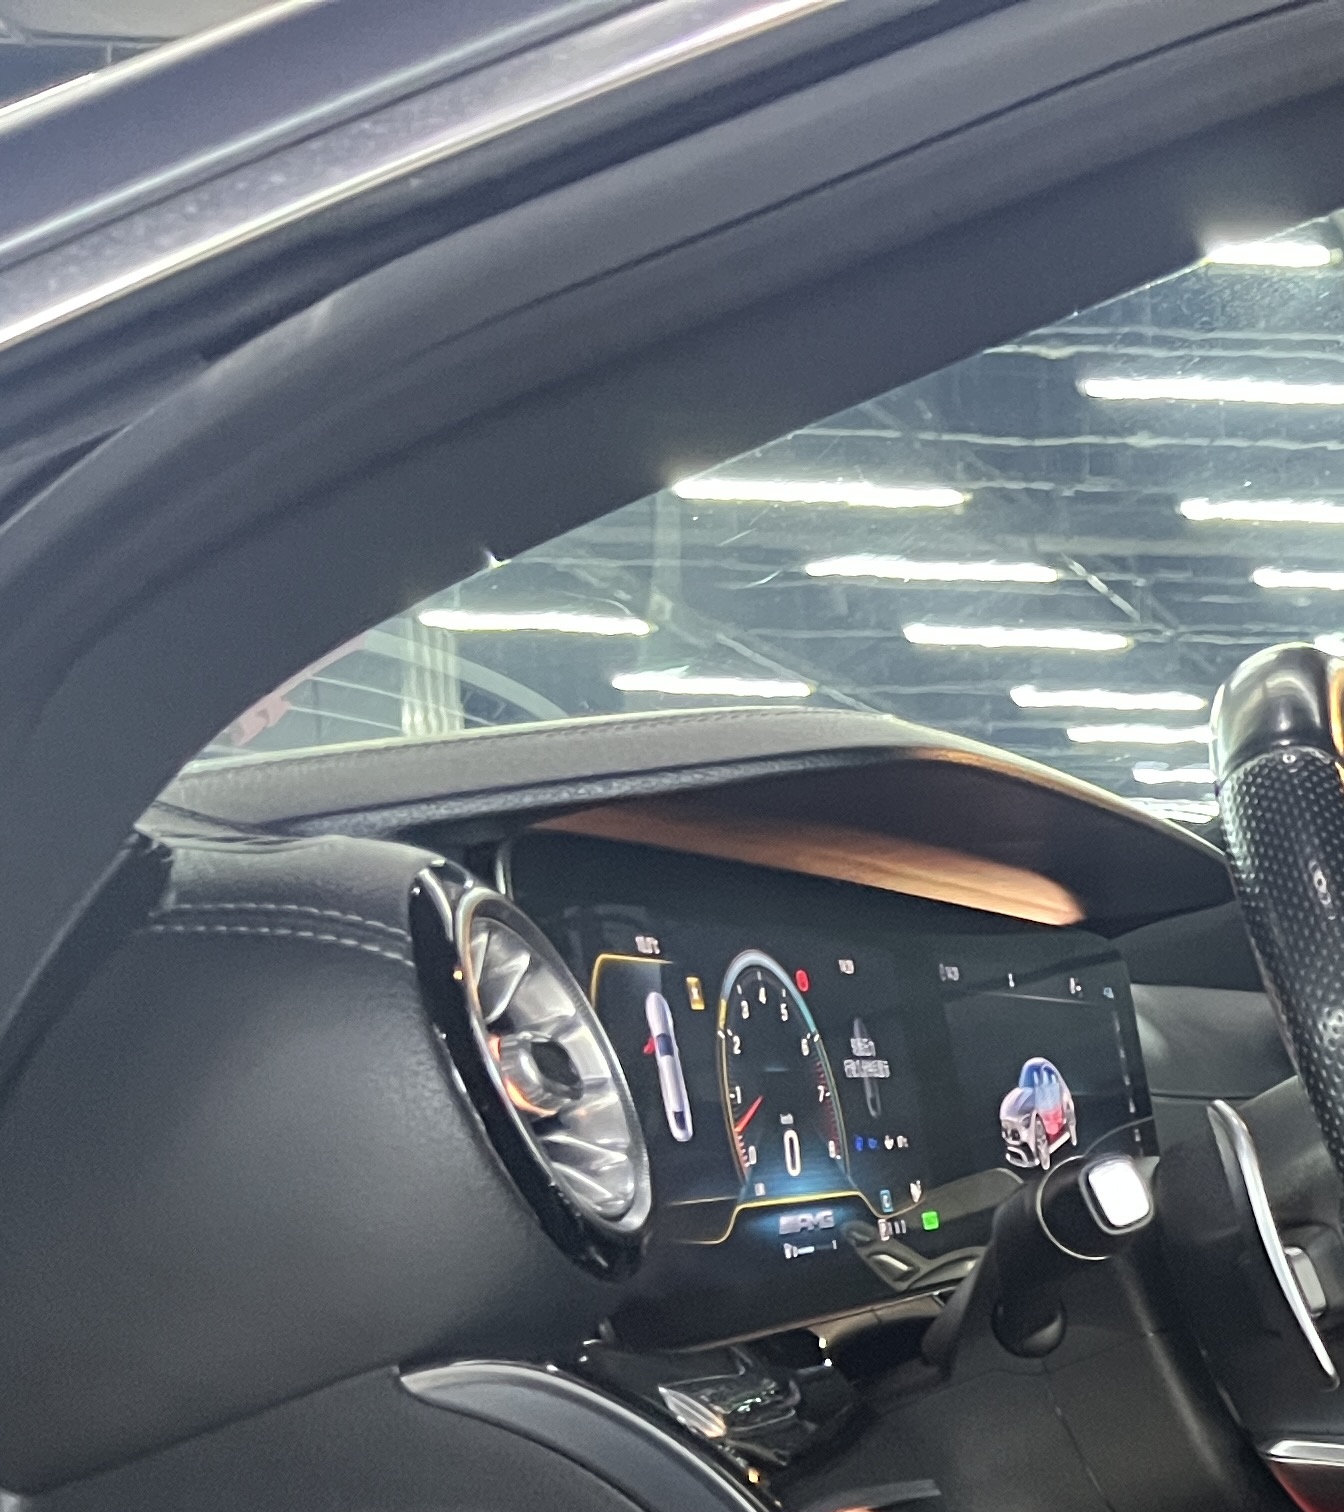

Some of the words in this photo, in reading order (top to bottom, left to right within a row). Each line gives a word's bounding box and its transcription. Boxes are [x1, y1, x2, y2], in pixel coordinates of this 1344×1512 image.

[780, 1002, 789, 1022] 5
[732, 1035, 742, 1055] 2
[783, 1129, 802, 1177] 0
